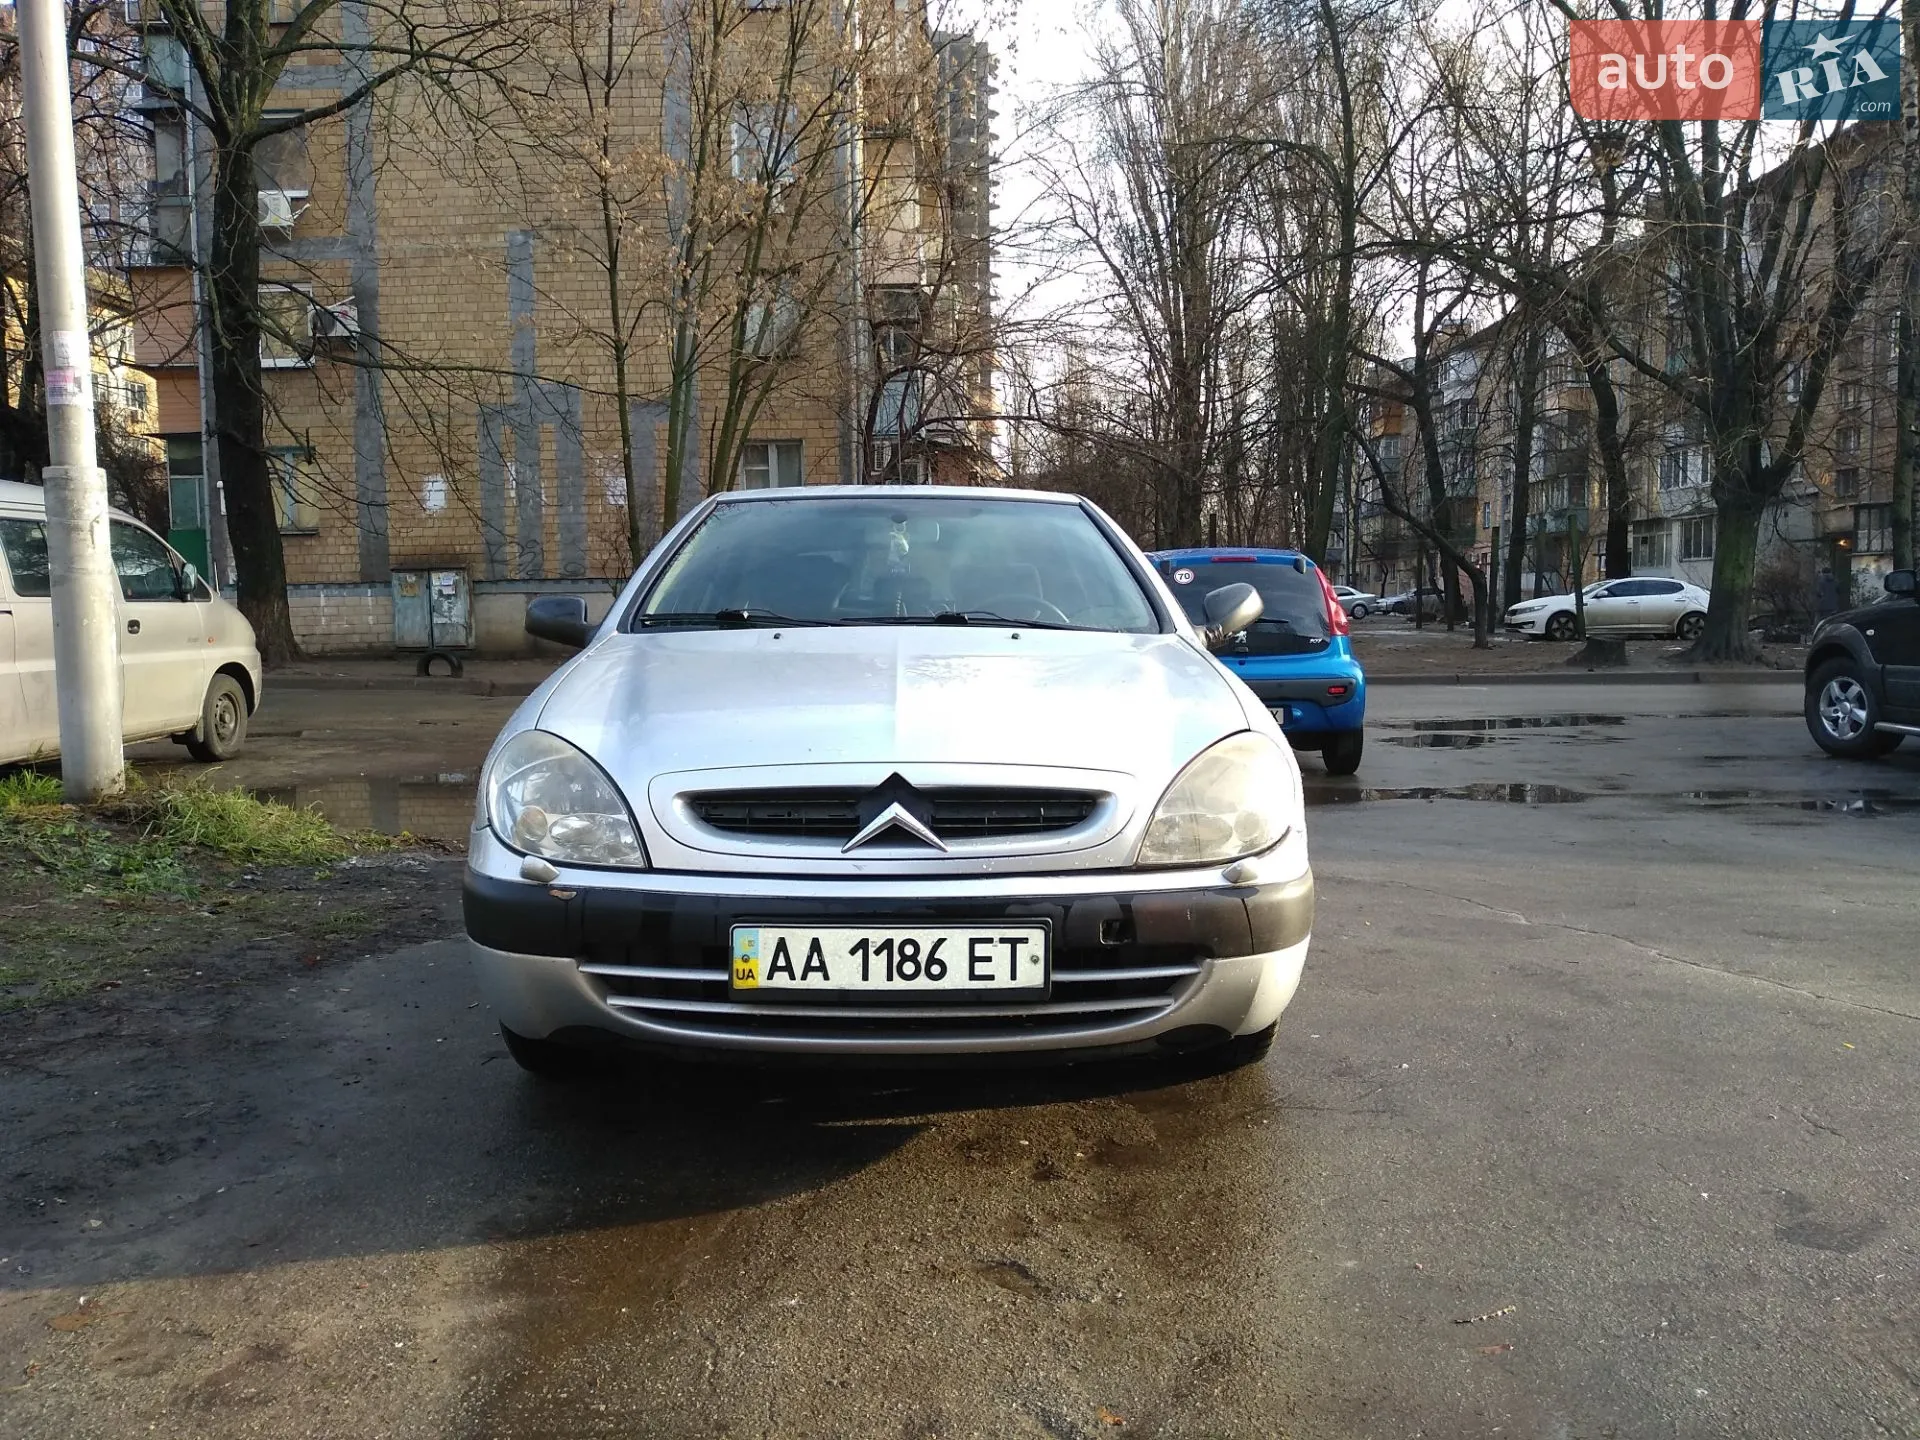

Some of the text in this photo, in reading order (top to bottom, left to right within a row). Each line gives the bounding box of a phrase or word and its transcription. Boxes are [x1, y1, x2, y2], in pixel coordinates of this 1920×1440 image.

[1177, 572, 1191, 580] 70
[766, 936, 1029, 982] AA 1186 ET
[736, 968, 756, 981] UA
